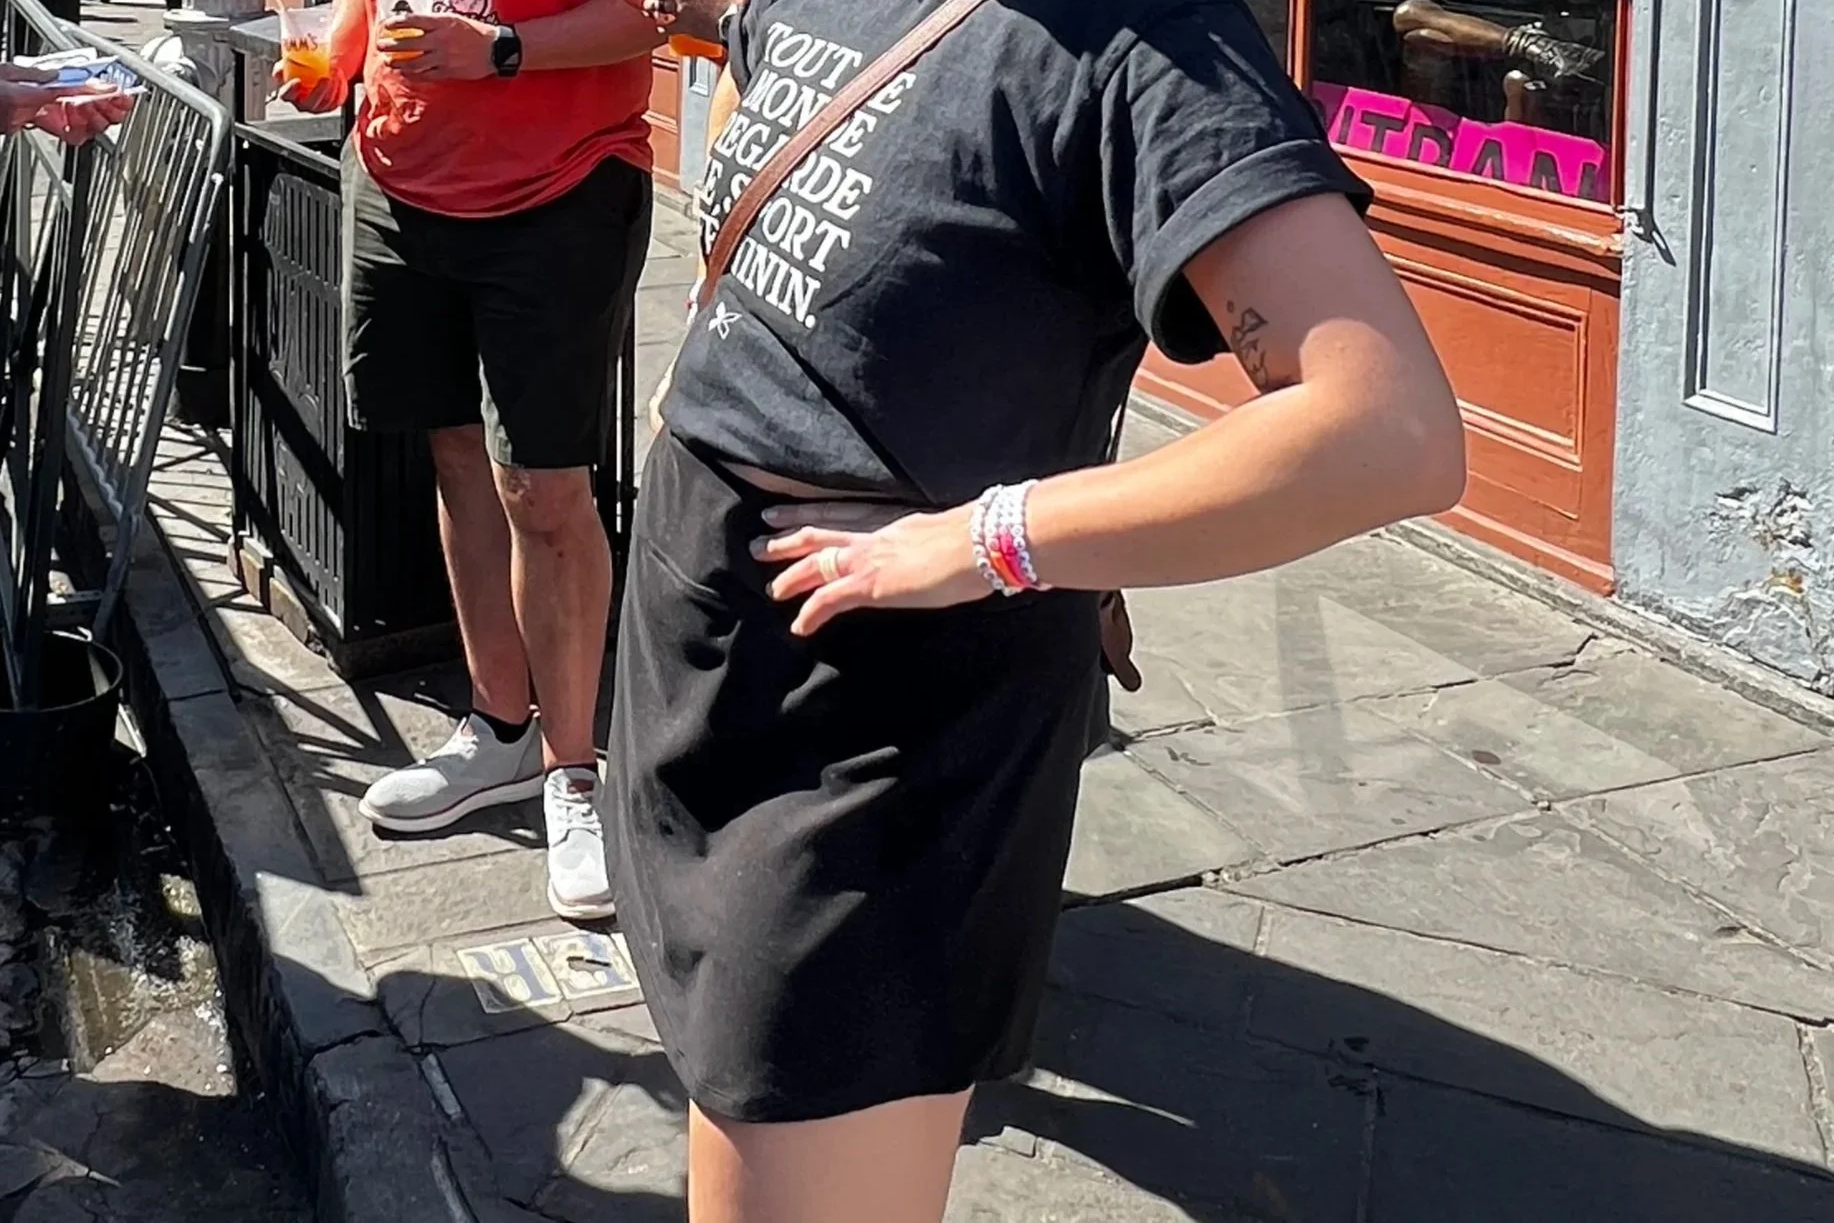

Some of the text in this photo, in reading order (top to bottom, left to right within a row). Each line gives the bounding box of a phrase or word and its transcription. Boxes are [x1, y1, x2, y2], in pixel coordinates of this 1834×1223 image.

[765, 22, 863, 90] TOUT
[743, 69, 878, 159] MONE
[723, 172, 852, 273] SORT
